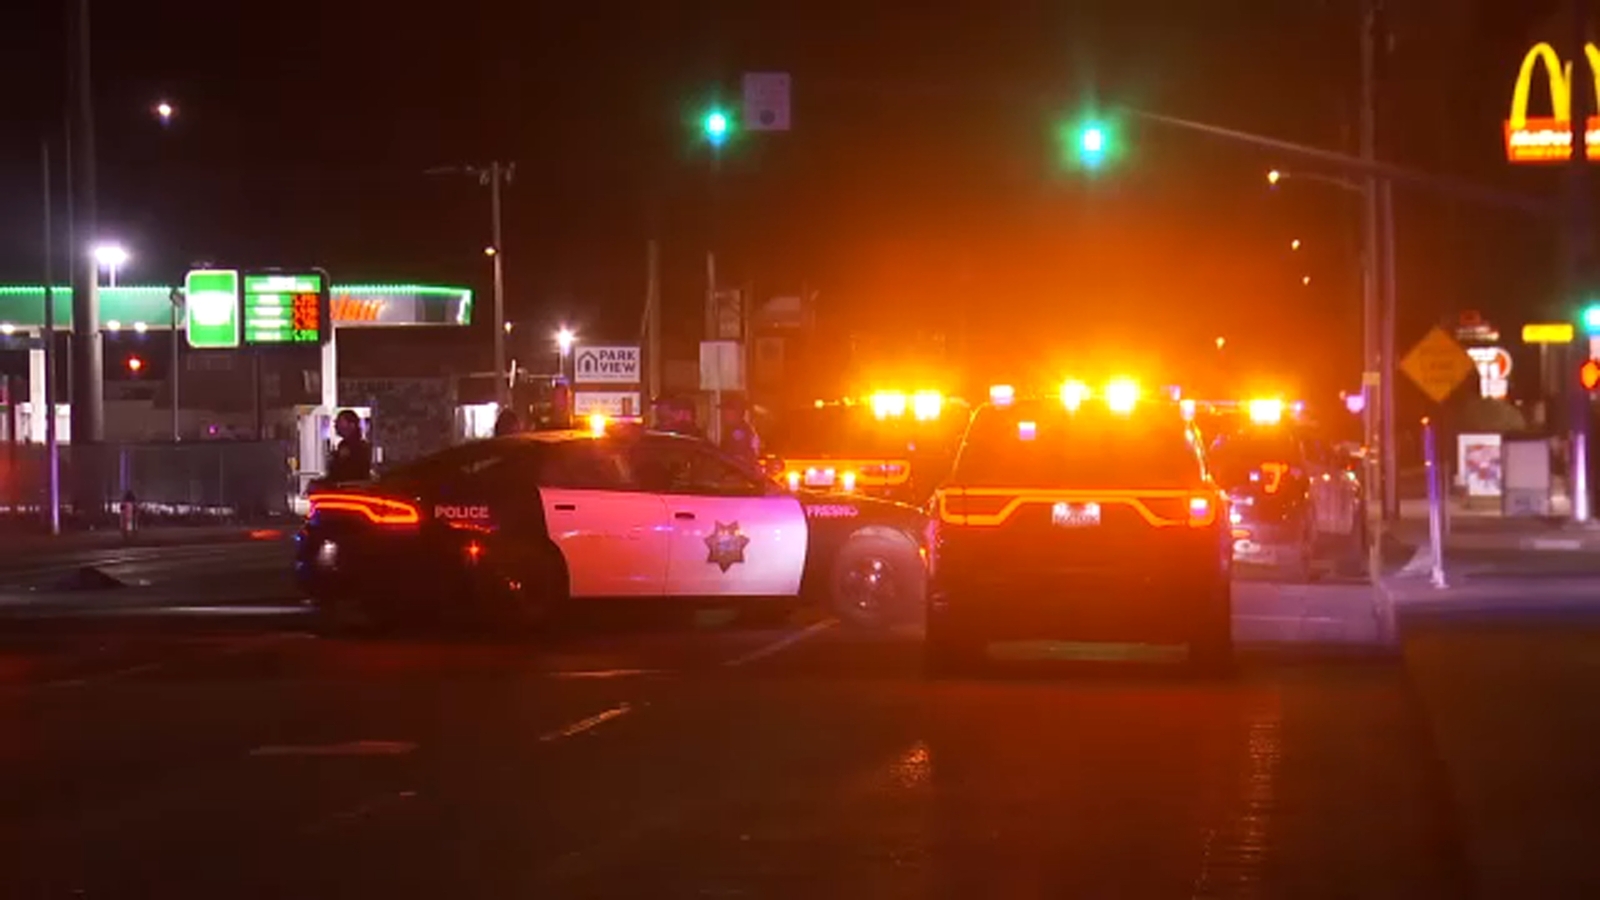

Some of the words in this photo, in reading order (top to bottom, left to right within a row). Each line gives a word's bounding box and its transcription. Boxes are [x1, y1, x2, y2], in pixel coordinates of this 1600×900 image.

[599, 349, 635, 360] PARK
[599, 362, 635, 373] VIEW
[434, 504, 490, 519] POLICE
[806, 503, 860, 519] FRESNO
